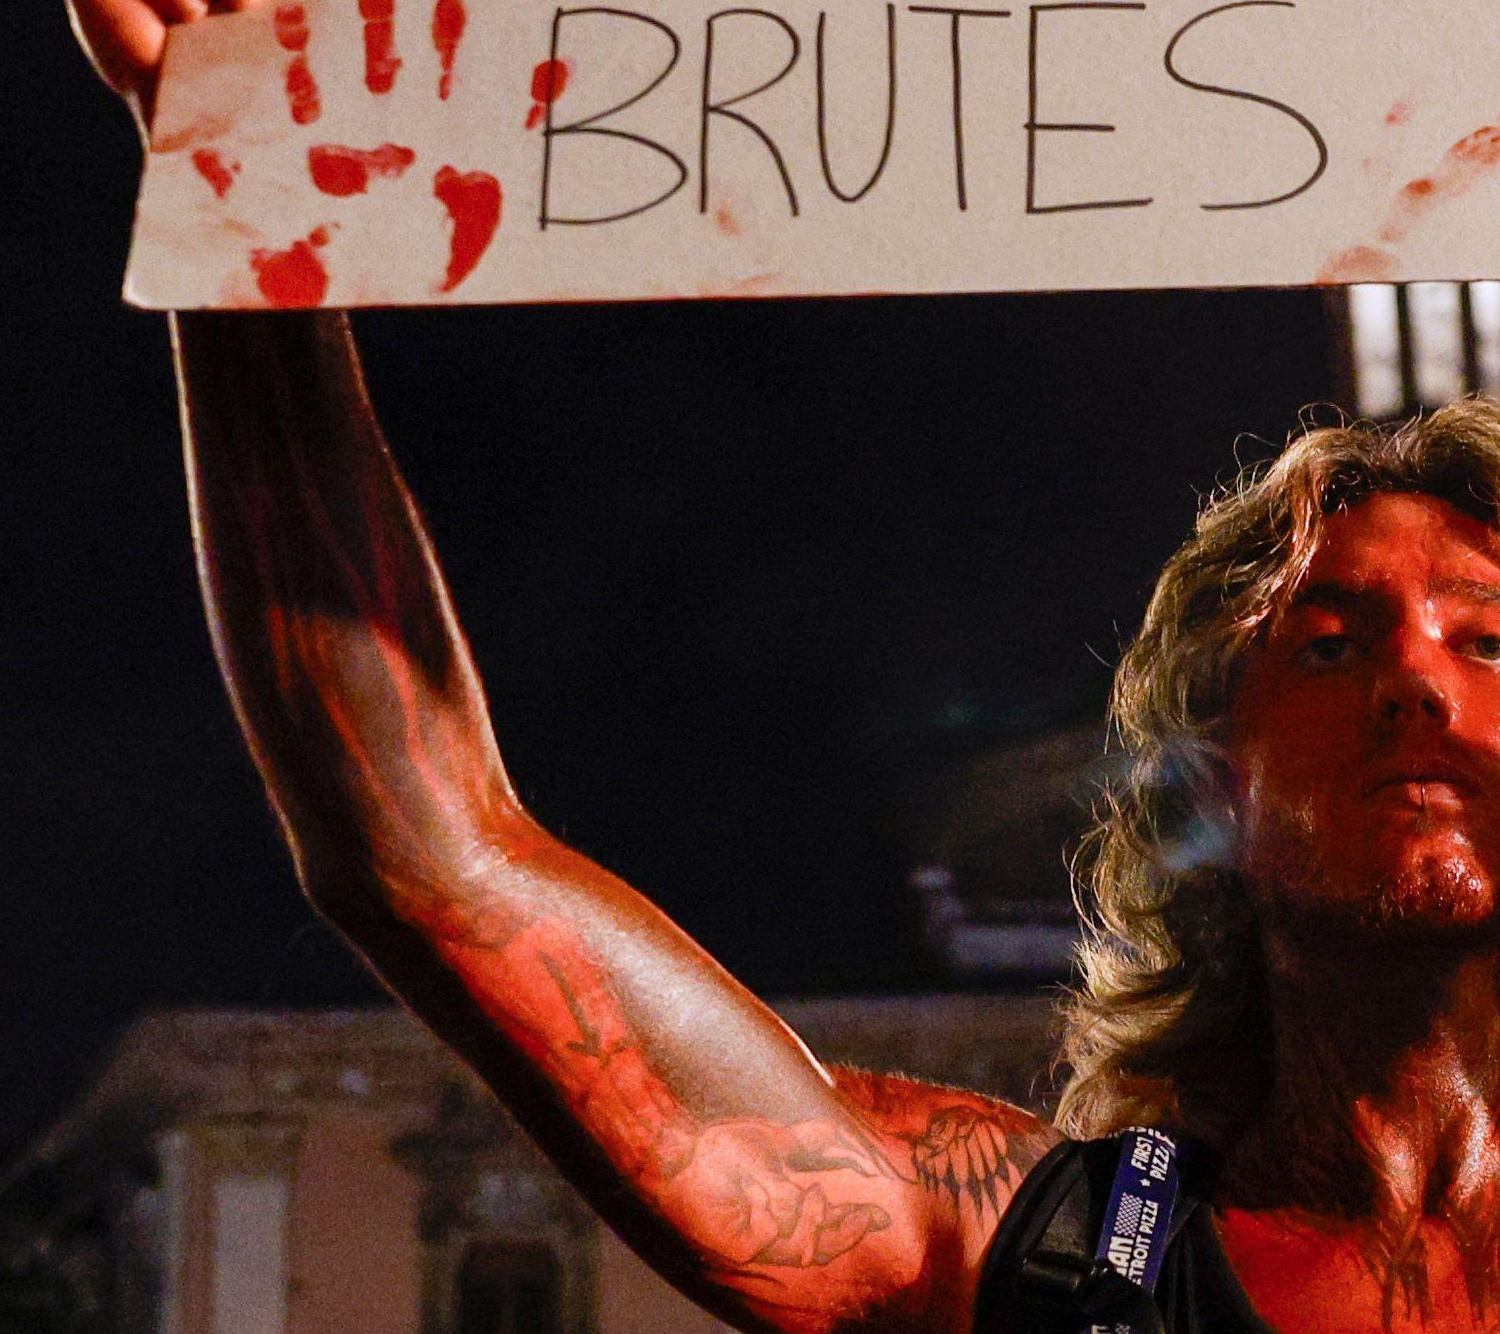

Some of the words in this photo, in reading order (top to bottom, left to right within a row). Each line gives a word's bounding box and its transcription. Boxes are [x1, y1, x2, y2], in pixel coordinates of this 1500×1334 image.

[541, 0, 1328, 230] BRUTES
[1130, 1135, 1153, 1171] FIRST
[1139, 1198, 1159, 1235] PIZZA
